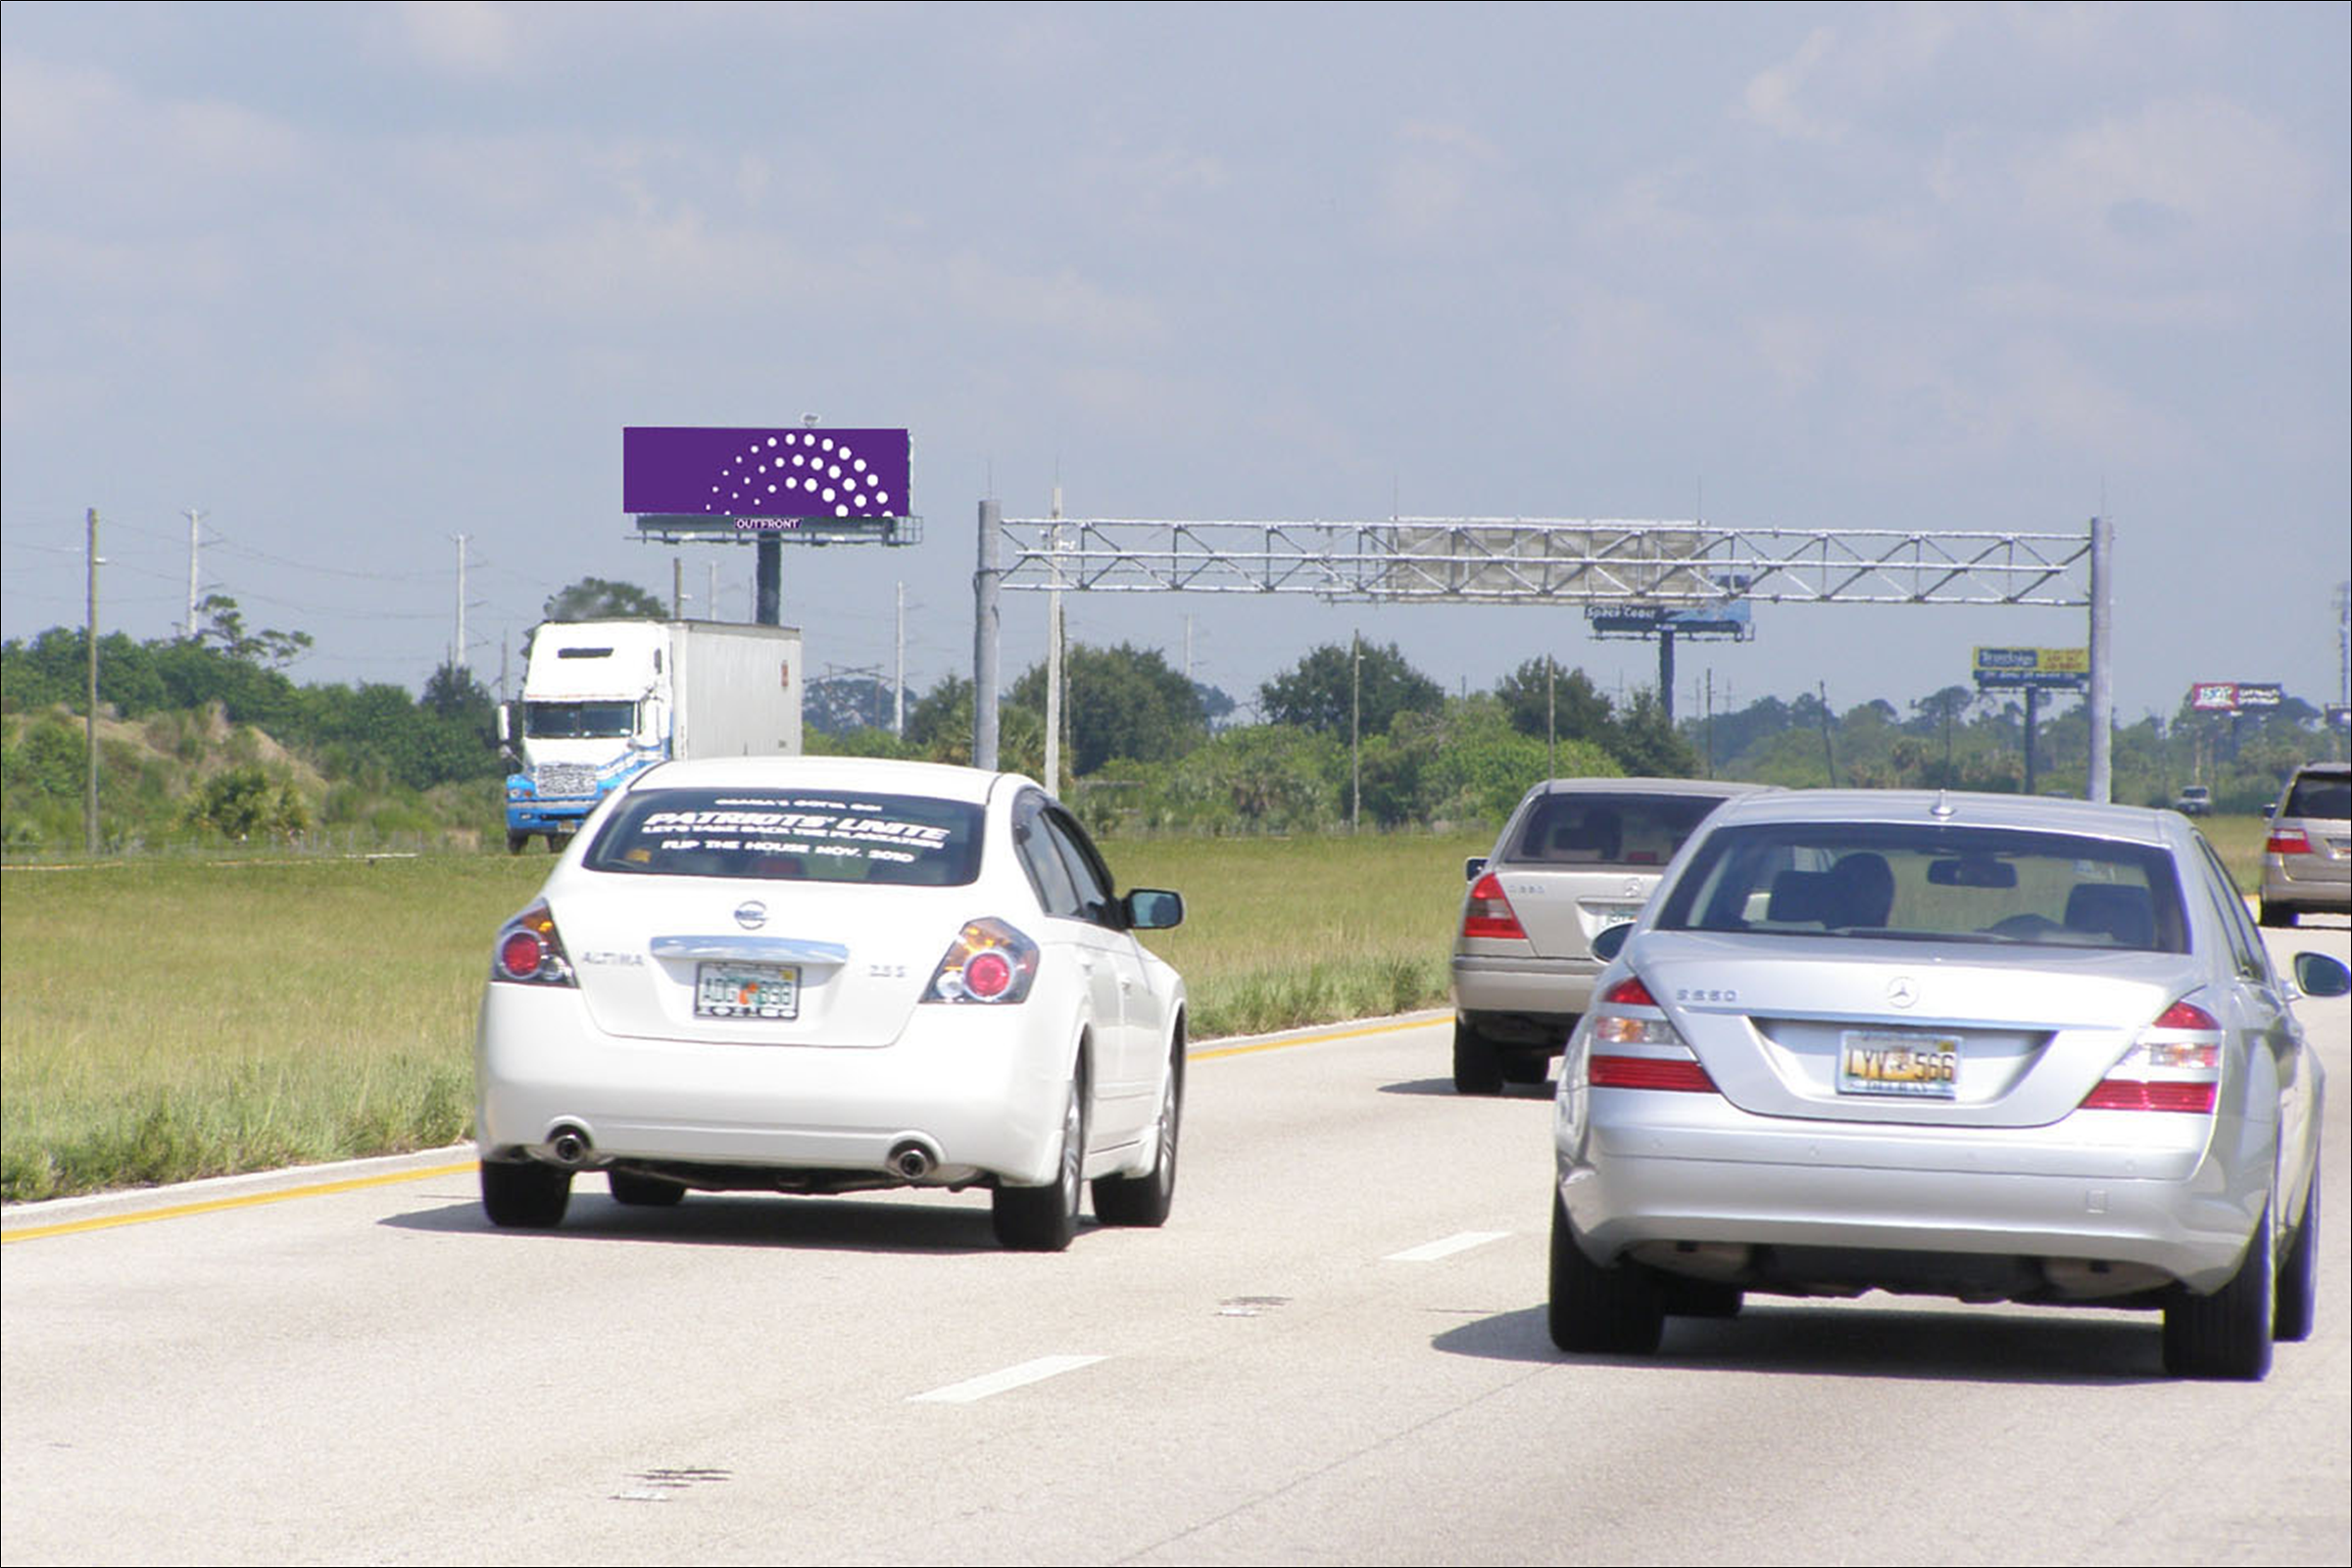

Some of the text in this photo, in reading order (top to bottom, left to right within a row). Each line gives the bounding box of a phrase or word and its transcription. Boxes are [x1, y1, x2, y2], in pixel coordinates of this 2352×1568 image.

[736, 518, 799, 529] OUTFRONT
[1588, 607, 1620, 619] Space
[836, 817, 952, 841] UNITE
[661, 840, 915, 863] FLIP THE HOUSE NOV. 2010
[1914, 1052, 1955, 1083] 566
